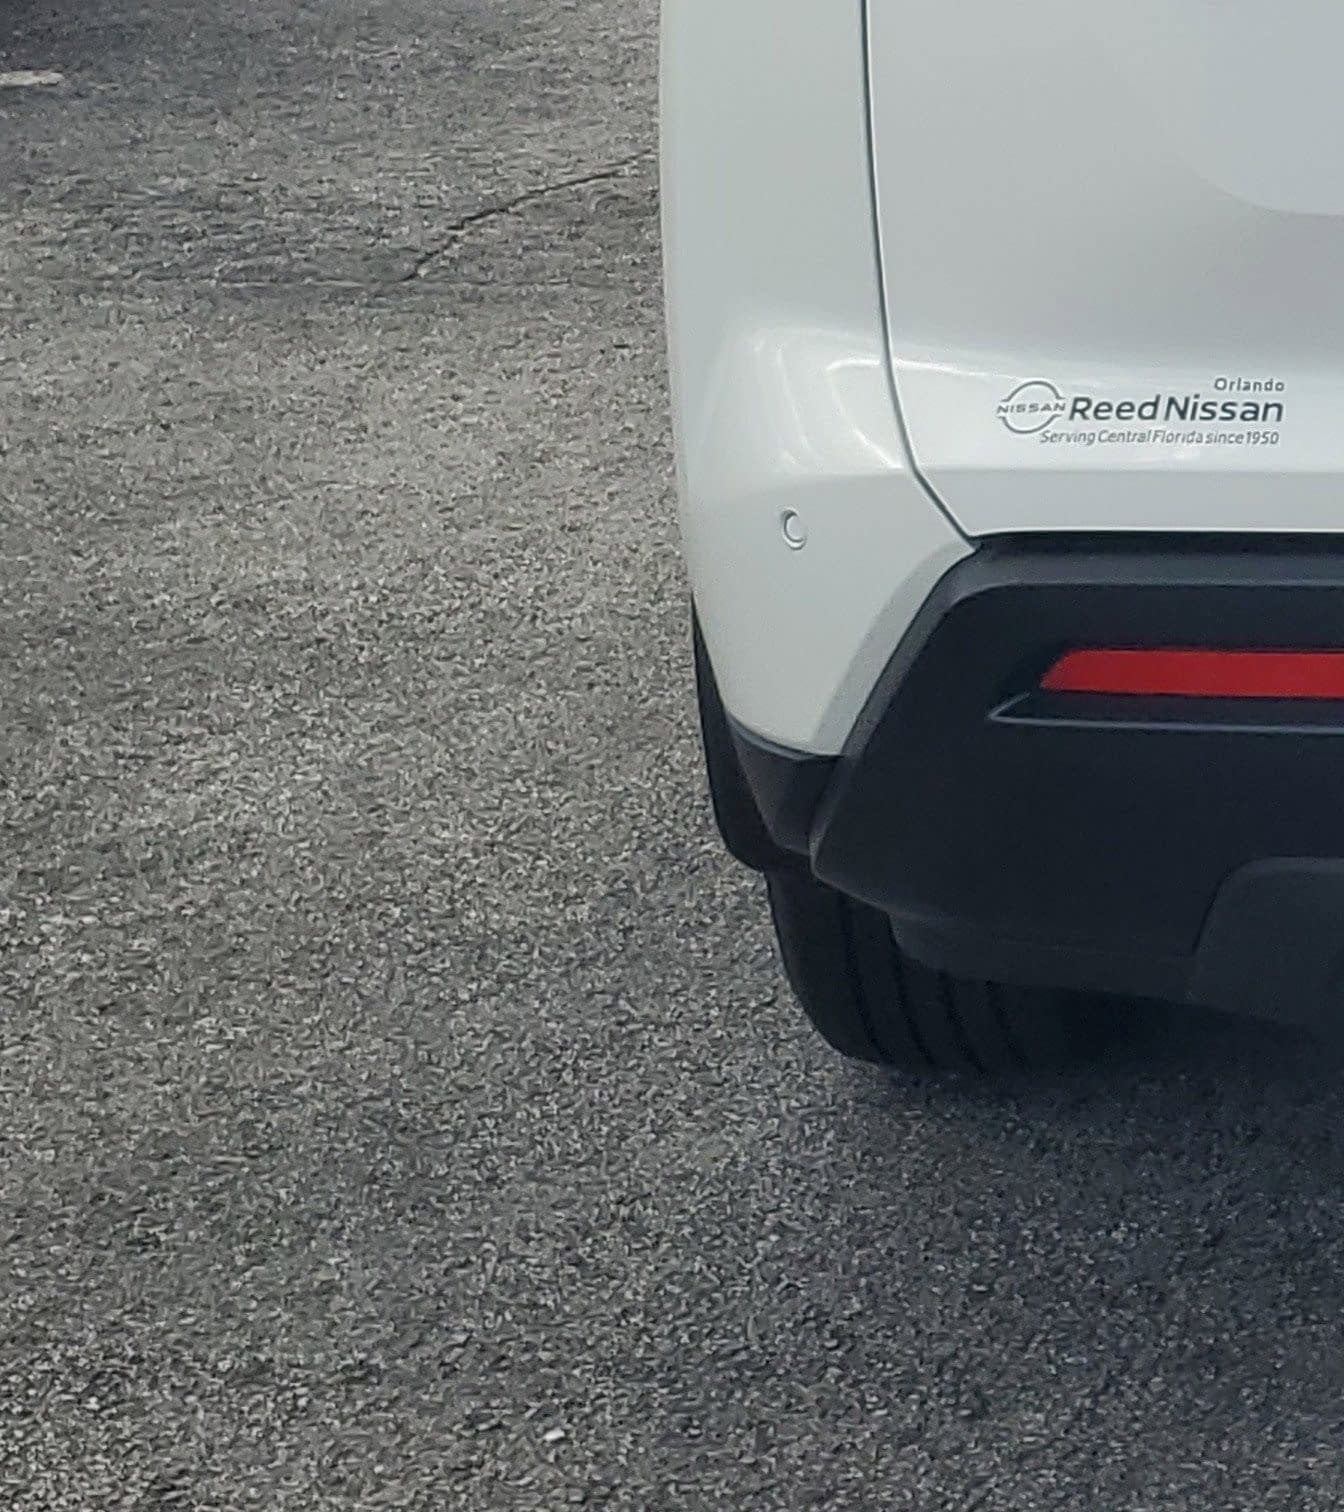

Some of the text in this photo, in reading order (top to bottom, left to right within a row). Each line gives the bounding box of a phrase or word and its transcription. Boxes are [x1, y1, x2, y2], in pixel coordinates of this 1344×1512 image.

[1213, 377, 1285, 392] Orlando
[997, 402, 1066, 414] NISSAN
[1068, 394, 1283, 422] Reed Nissan
[1041, 430, 1095, 446] Serving
[1097, 430, 1150, 444] Central
